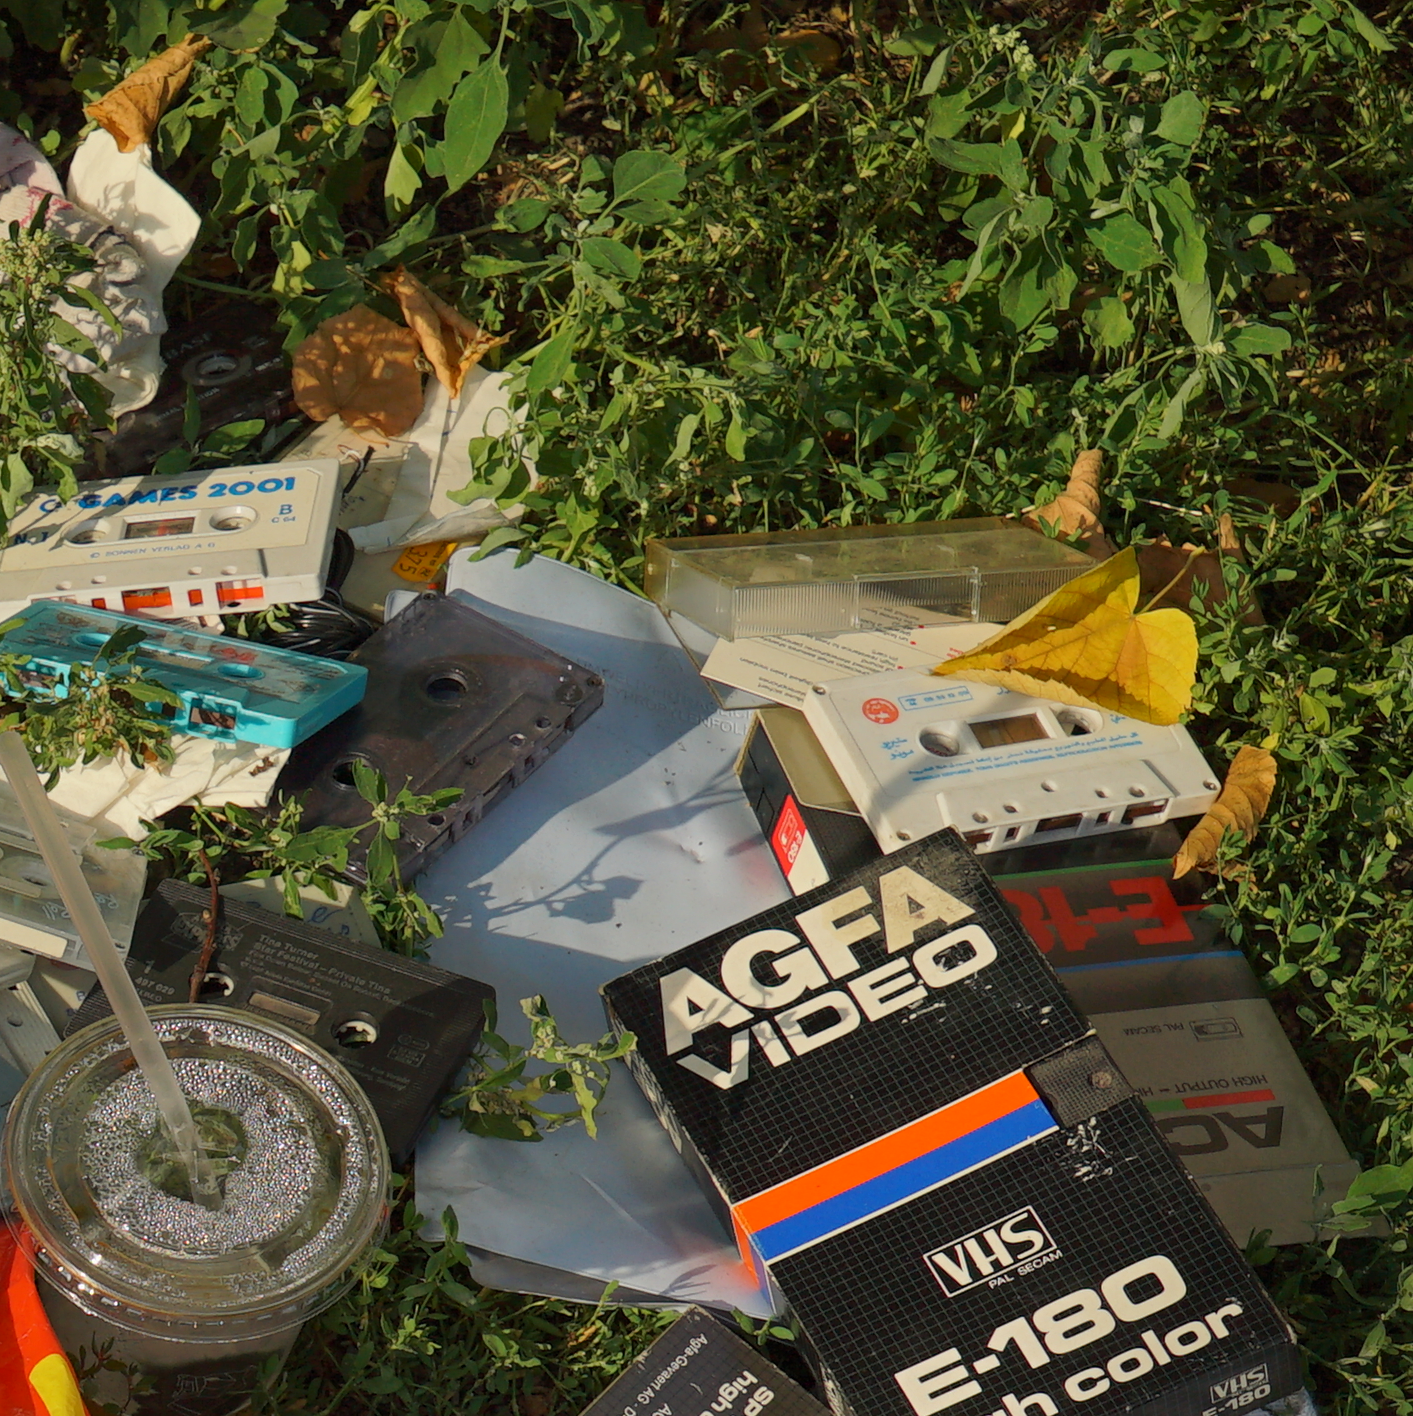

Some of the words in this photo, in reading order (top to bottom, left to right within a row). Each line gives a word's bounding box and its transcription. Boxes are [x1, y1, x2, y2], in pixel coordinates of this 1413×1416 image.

[77, 484, 198, 510] GAMES
[207, 475, 295, 498] 2001
[279, 503, 292, 515] B
[257, 934, 285, 950] Tina
[282, 943, 320, 961] Turner
[658, 866, 975, 1057] AGFA
[251, 942, 276, 958] Star
[275, 950, 320, 971] Festival
[326, 967, 367, 987] Private
[367, 980, 392, 995] Tina
[676, 923, 998, 1091] VIDEO
[1173, 1077, 1230, 1093] OUTPUT
[1230, 1073, 1268, 1087] HIGH
[929, 1213, 1049, 1291] VHS
[988, 1273, 1014, 1290] PAL
[1016, 1249, 1063, 1280] SECAM
[648, 1331, 710, 1391] Agfa-Gevaert
[1063, 1299, 1245, 1403] color
[635, 1385, 658, 1405] AG
[704, 1366, 760, 1415] high
[1212, 1365, 1266, 1400] VHS
